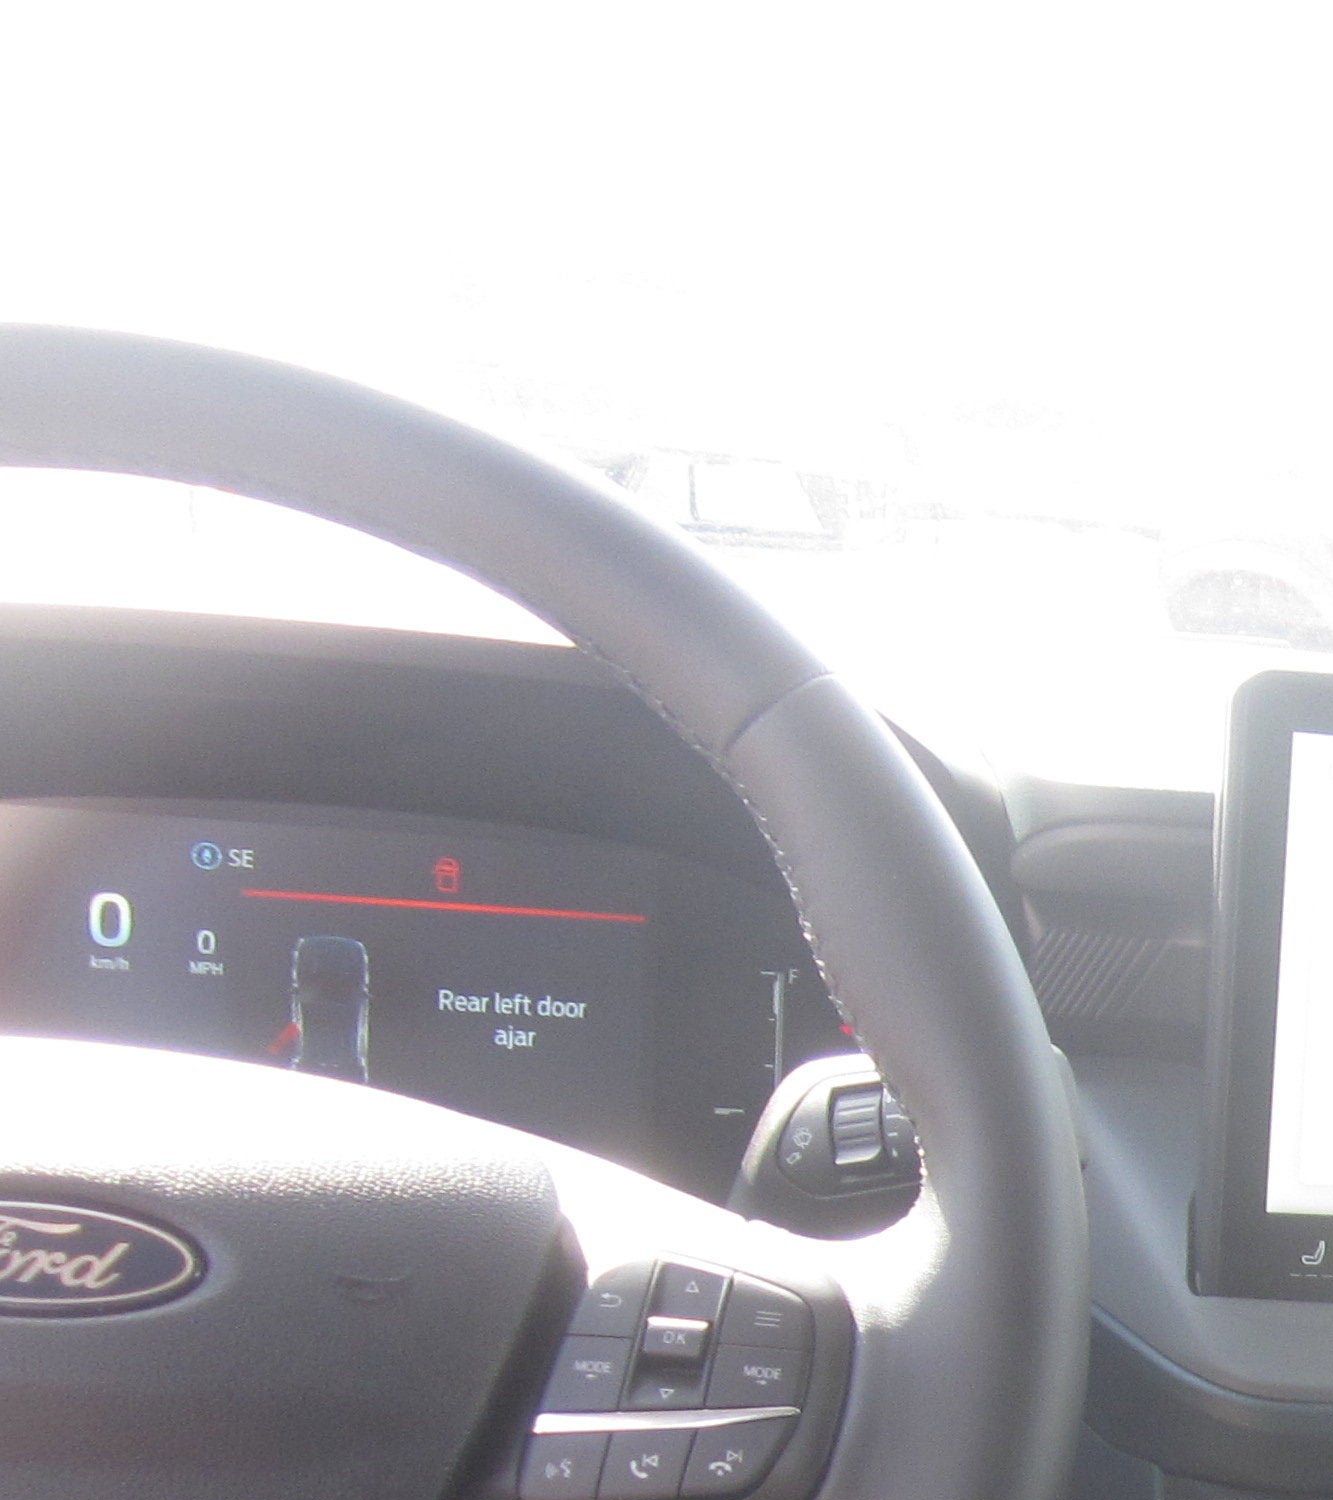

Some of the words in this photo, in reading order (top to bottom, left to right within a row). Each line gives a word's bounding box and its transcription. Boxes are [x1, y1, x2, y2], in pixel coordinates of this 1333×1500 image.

[228, 848, 254, 869] SE
[88, 891, 134, 948] 0
[197, 929, 217, 955] 0
[90, 954, 130, 971] km/h
[188, 960, 224, 976] MPH
[788, 968, 798, 984] F
[438, 989, 489, 1013] Rear
[495, 992, 531, 1016] left
[537, 995, 586, 1019] door
[494, 1026, 536, 1049] ajar
[663, 1331, 686, 1344] OK
[574, 1360, 612, 1373] MODE
[743, 1365, 783, 1380] MODE
